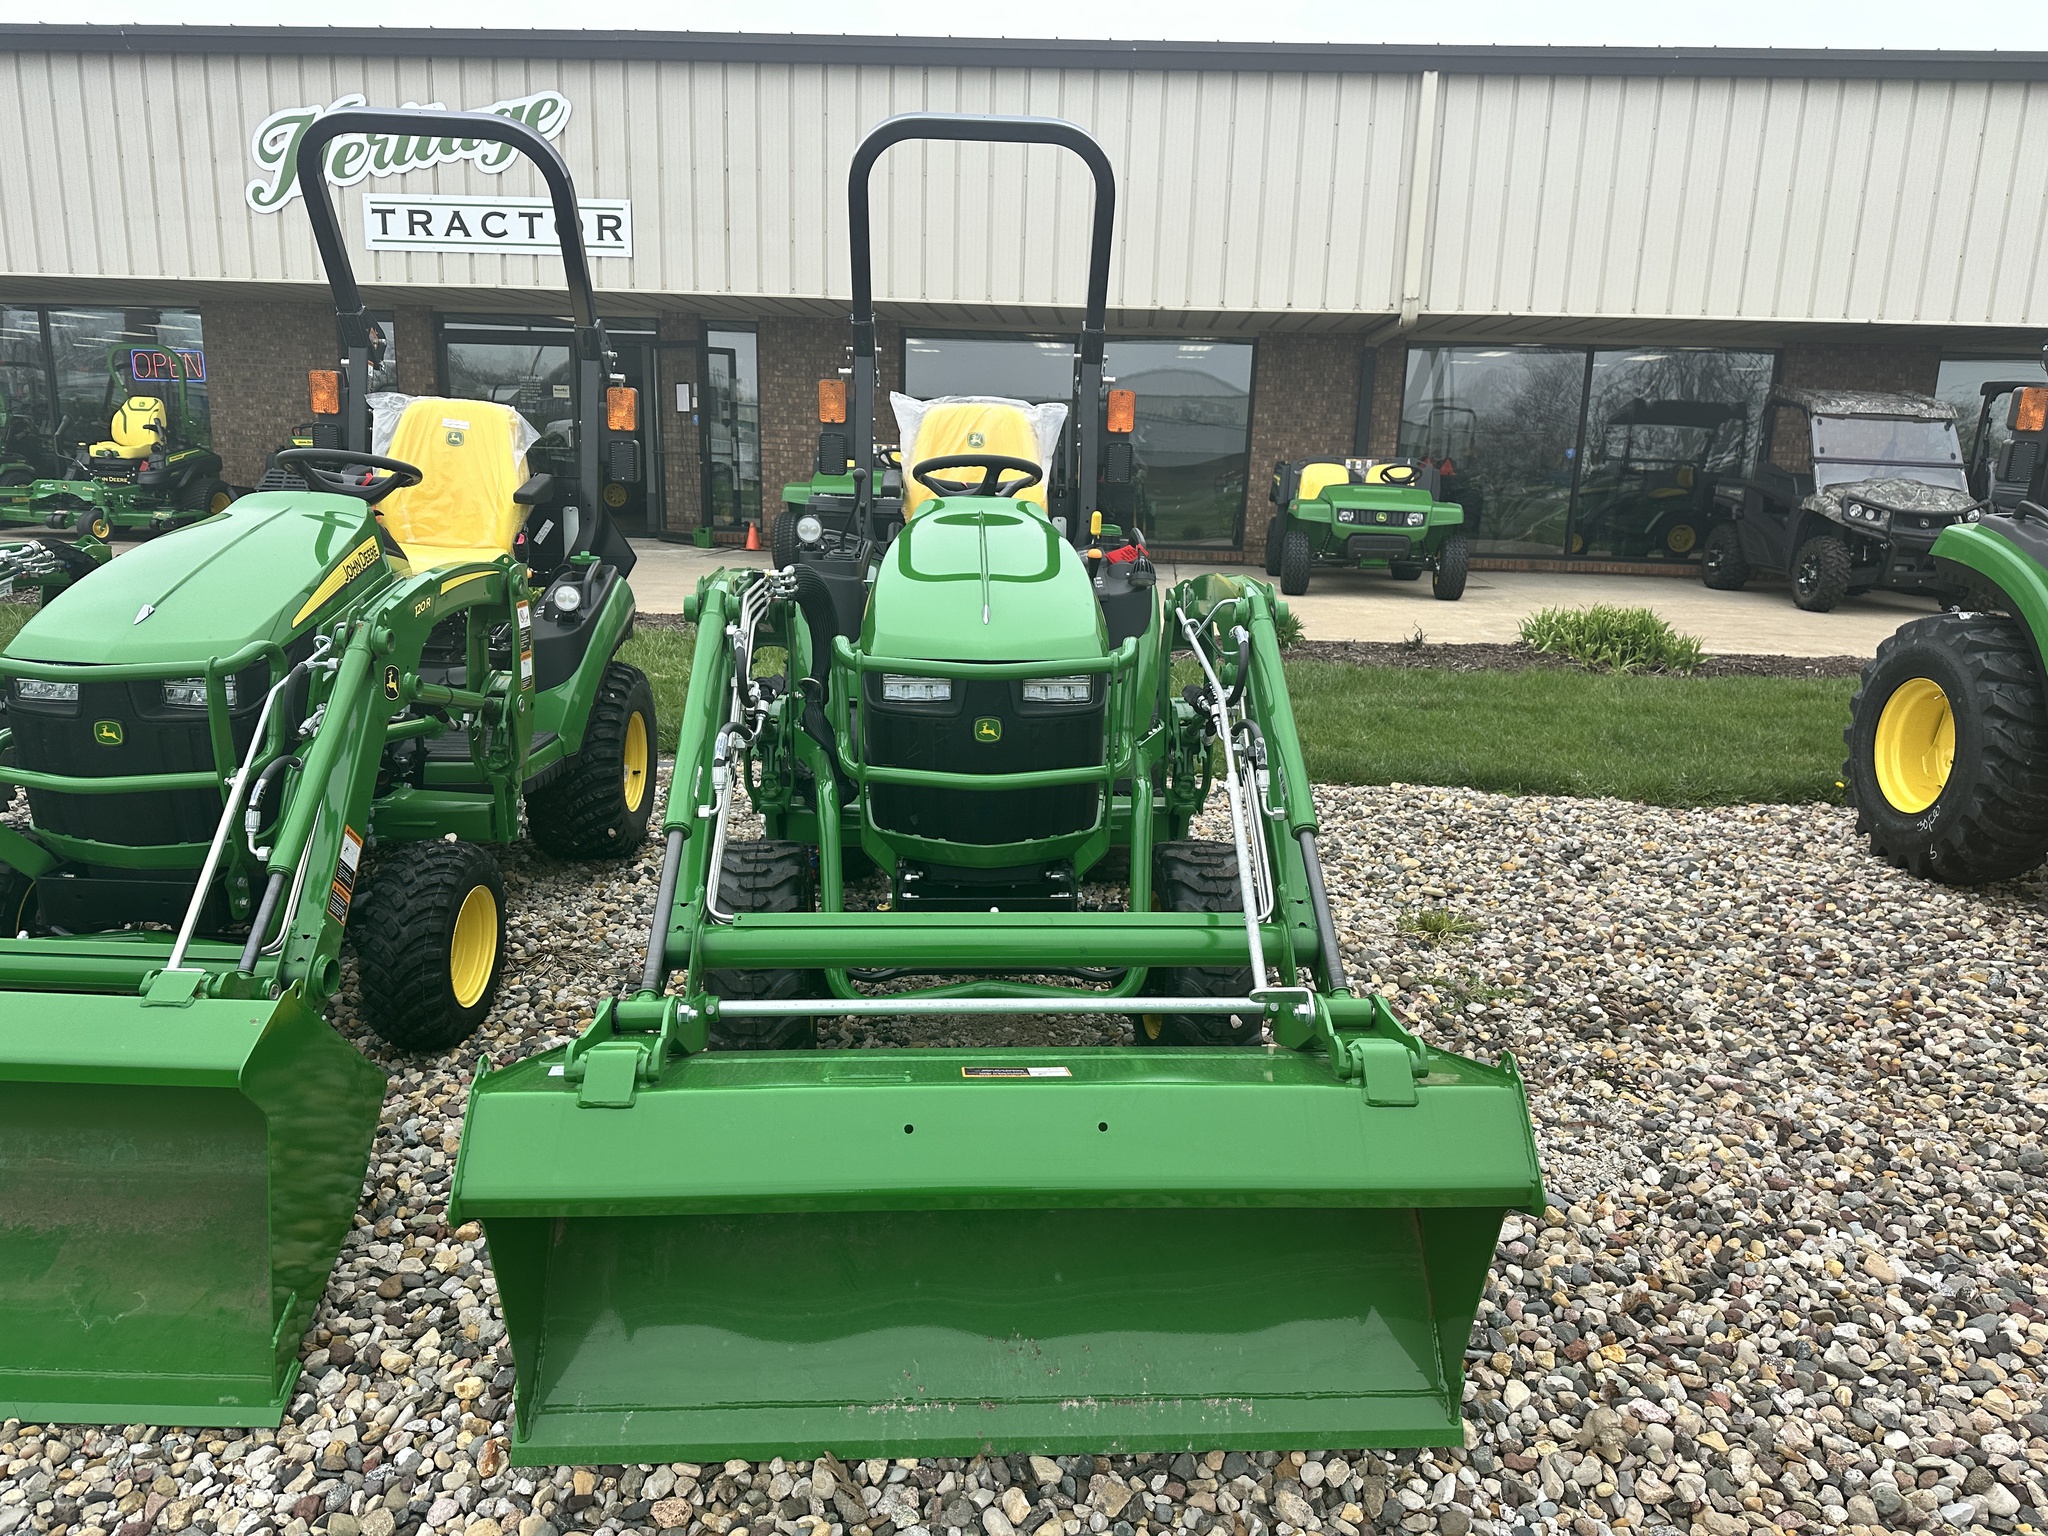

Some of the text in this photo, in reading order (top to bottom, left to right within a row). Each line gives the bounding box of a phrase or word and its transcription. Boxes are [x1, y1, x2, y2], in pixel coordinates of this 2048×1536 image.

[133, 352, 203, 378] OPEN
[343, 545, 379, 582] JOHN DEERE
